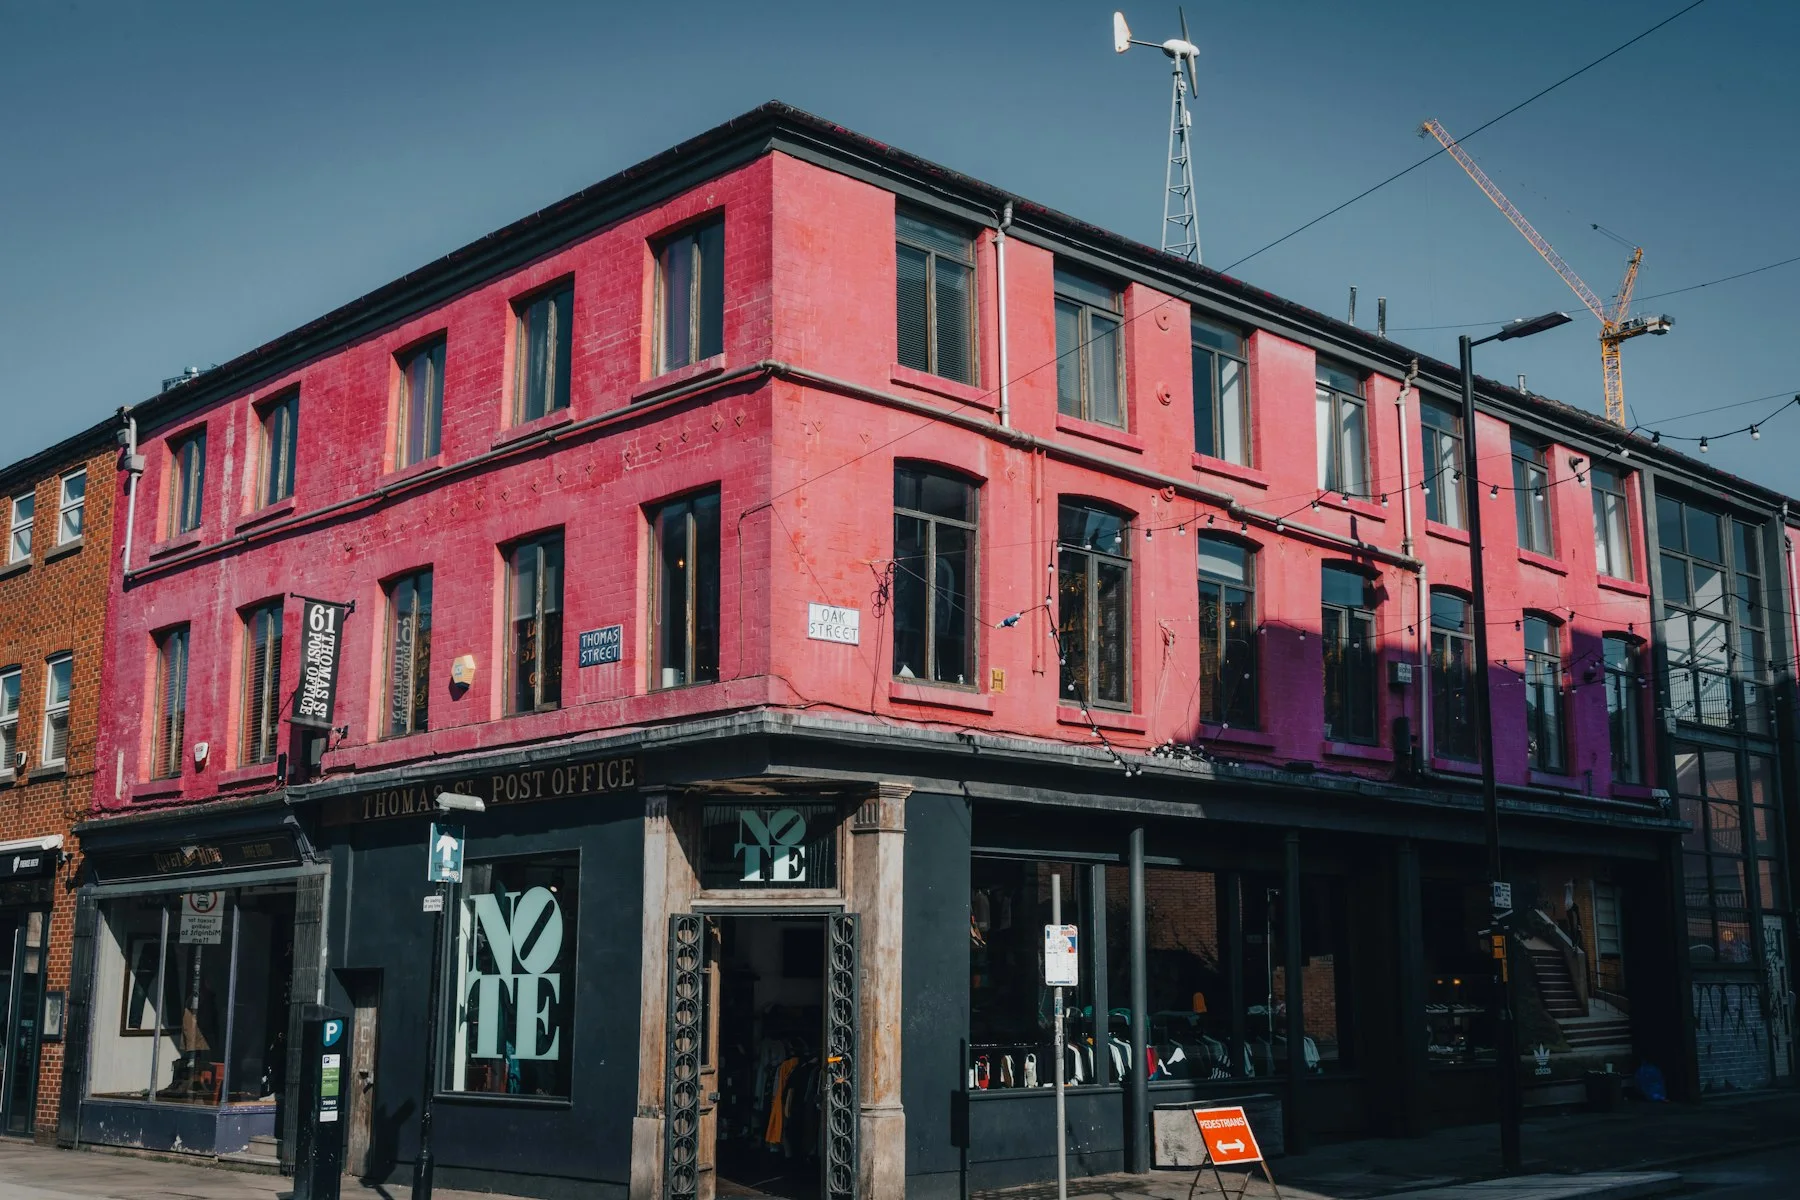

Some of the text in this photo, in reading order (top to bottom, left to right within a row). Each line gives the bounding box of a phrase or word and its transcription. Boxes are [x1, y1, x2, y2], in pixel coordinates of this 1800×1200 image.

[309, 604, 335, 634] 61
[822, 608, 846, 625] OAK
[581, 628, 619, 648] THOMAS
[810, 622, 858, 641] STREET
[581, 645, 618, 664] STREET
[299, 631, 322, 716] POST OFFICE
[314, 633, 336, 700] THOMAS
[491, 770, 545, 802] POST
[551, 758, 635, 795] OFFICE
[326, 1022, 338, 1042] P
[1200, 1117, 1245, 1129] PEDESTRIANS
